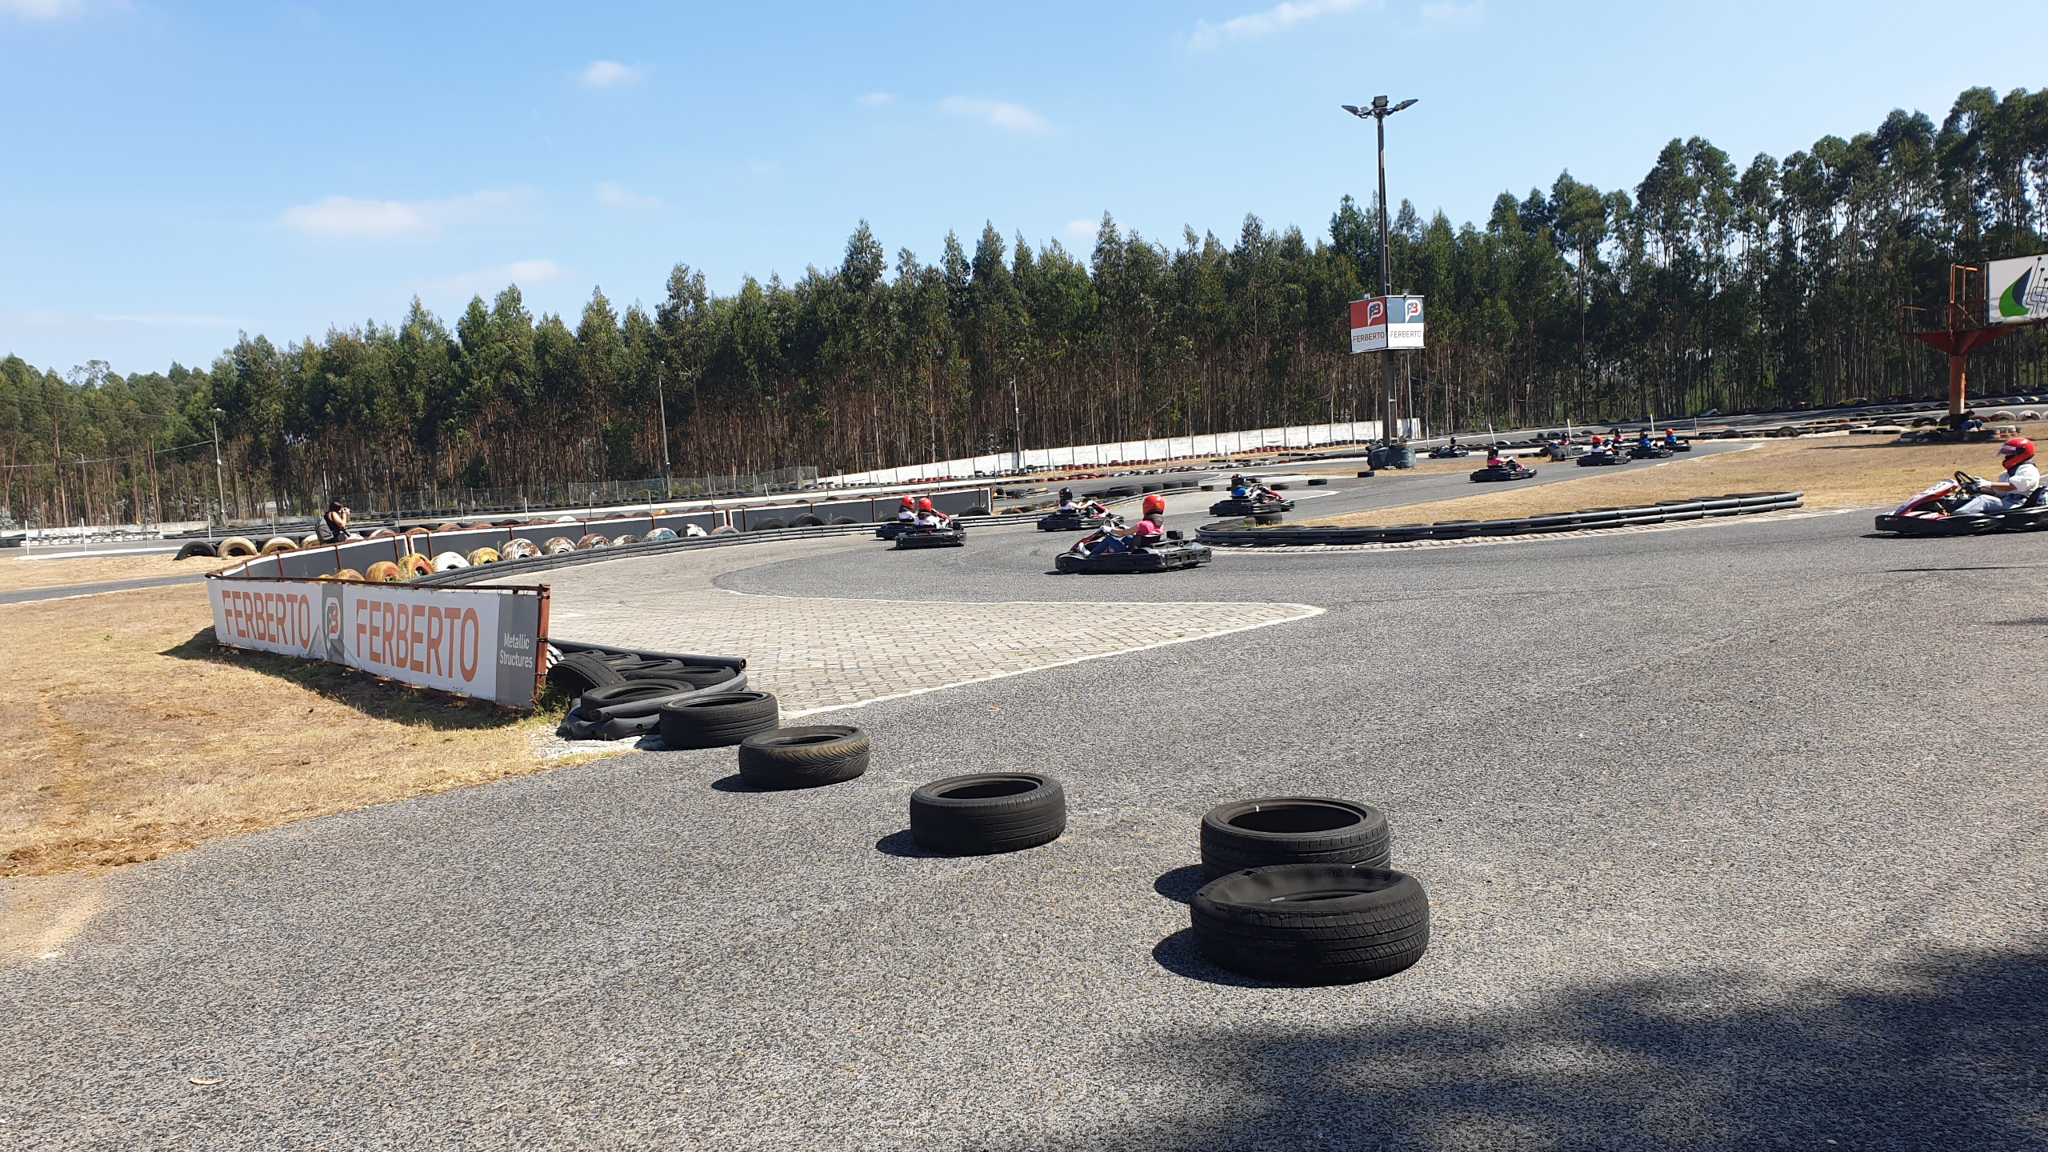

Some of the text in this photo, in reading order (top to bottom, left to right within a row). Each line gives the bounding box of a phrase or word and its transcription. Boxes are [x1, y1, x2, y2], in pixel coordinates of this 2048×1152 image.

[1353, 331, 1385, 343] FERBERTO
[1389, 330, 1422, 339] FERBERTO
[221, 589, 311, 650] FERBERTO
[356, 598, 480, 683] FERBERTO
[503, 632, 530, 650] Metallic
[499, 649, 533, 669] Structures
